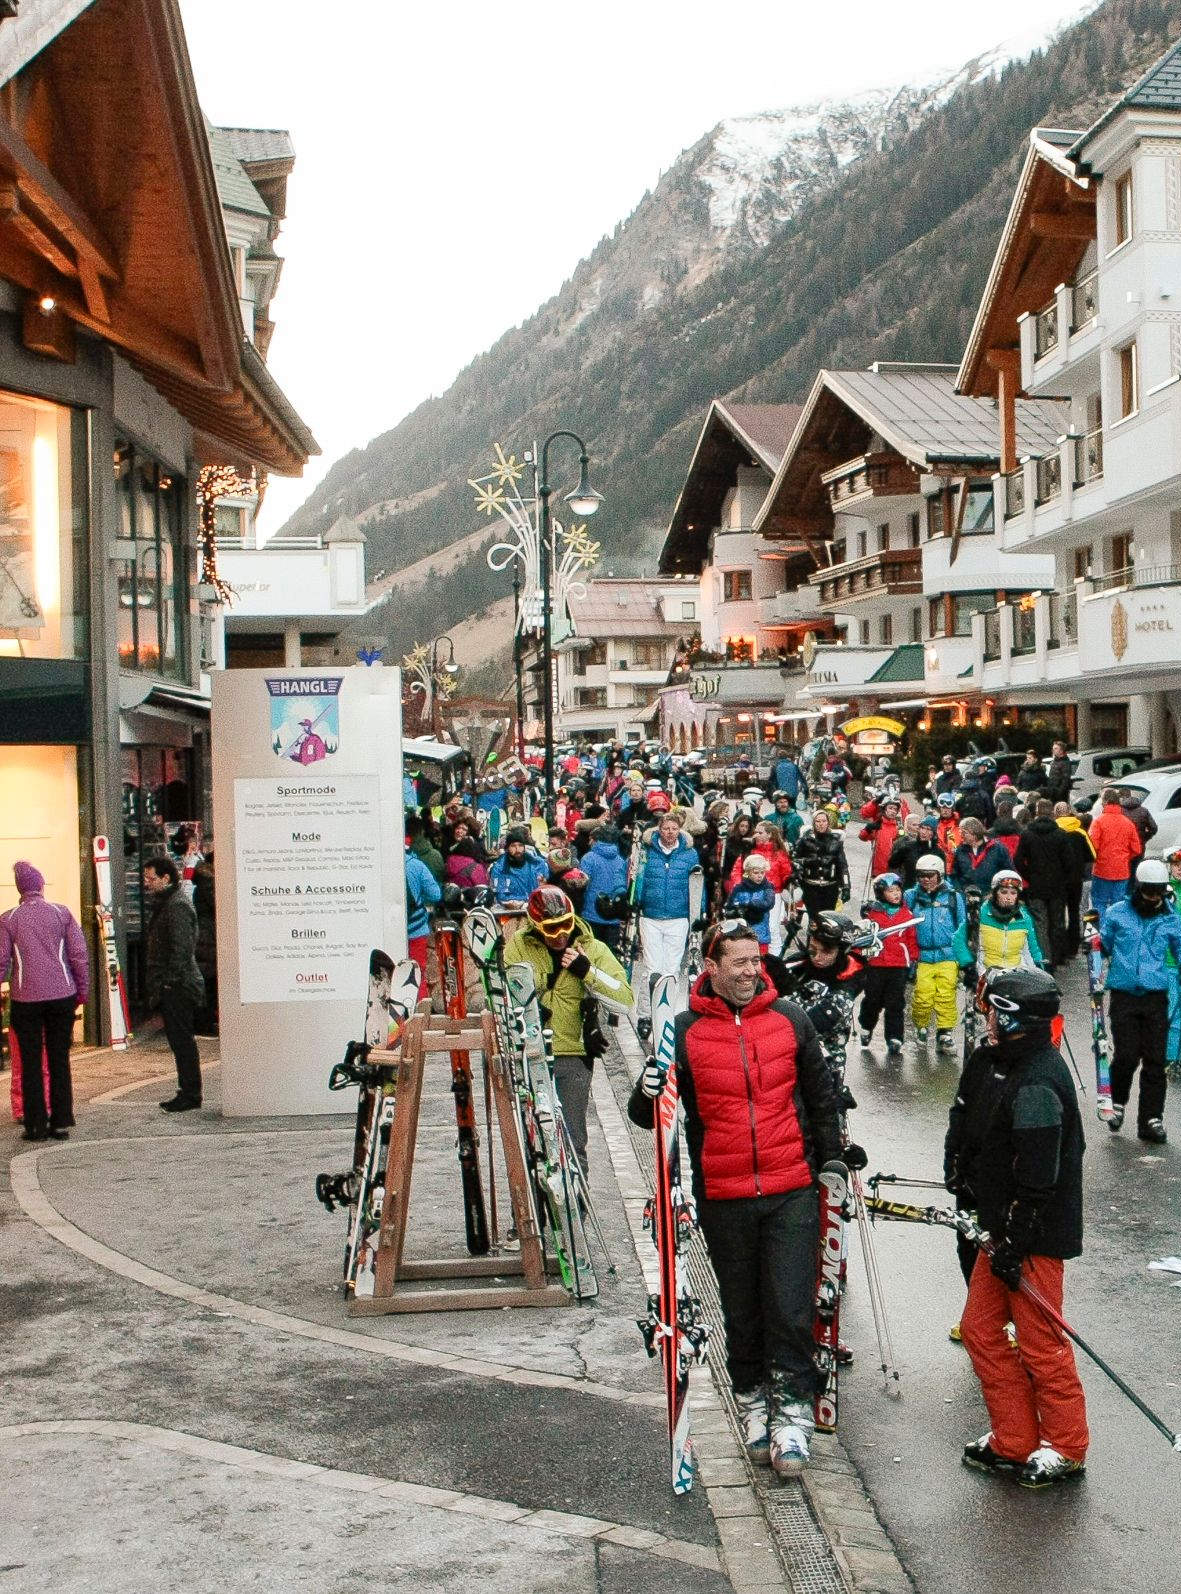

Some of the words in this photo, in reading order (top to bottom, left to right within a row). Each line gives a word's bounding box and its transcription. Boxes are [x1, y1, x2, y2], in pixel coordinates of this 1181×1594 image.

[1134, 618, 1174, 633] HOTEL
[280, 680, 328, 694] HANGL
[276, 785, 337, 797] Sportmode
[291, 832, 321, 842] Mode
[250, 885, 291, 895] Schuhe
[294, 885, 302, 894] &
[305, 883, 366, 894] Accessoire
[291, 929, 327, 939] Brillen
[295, 973, 329, 982] Outlet
